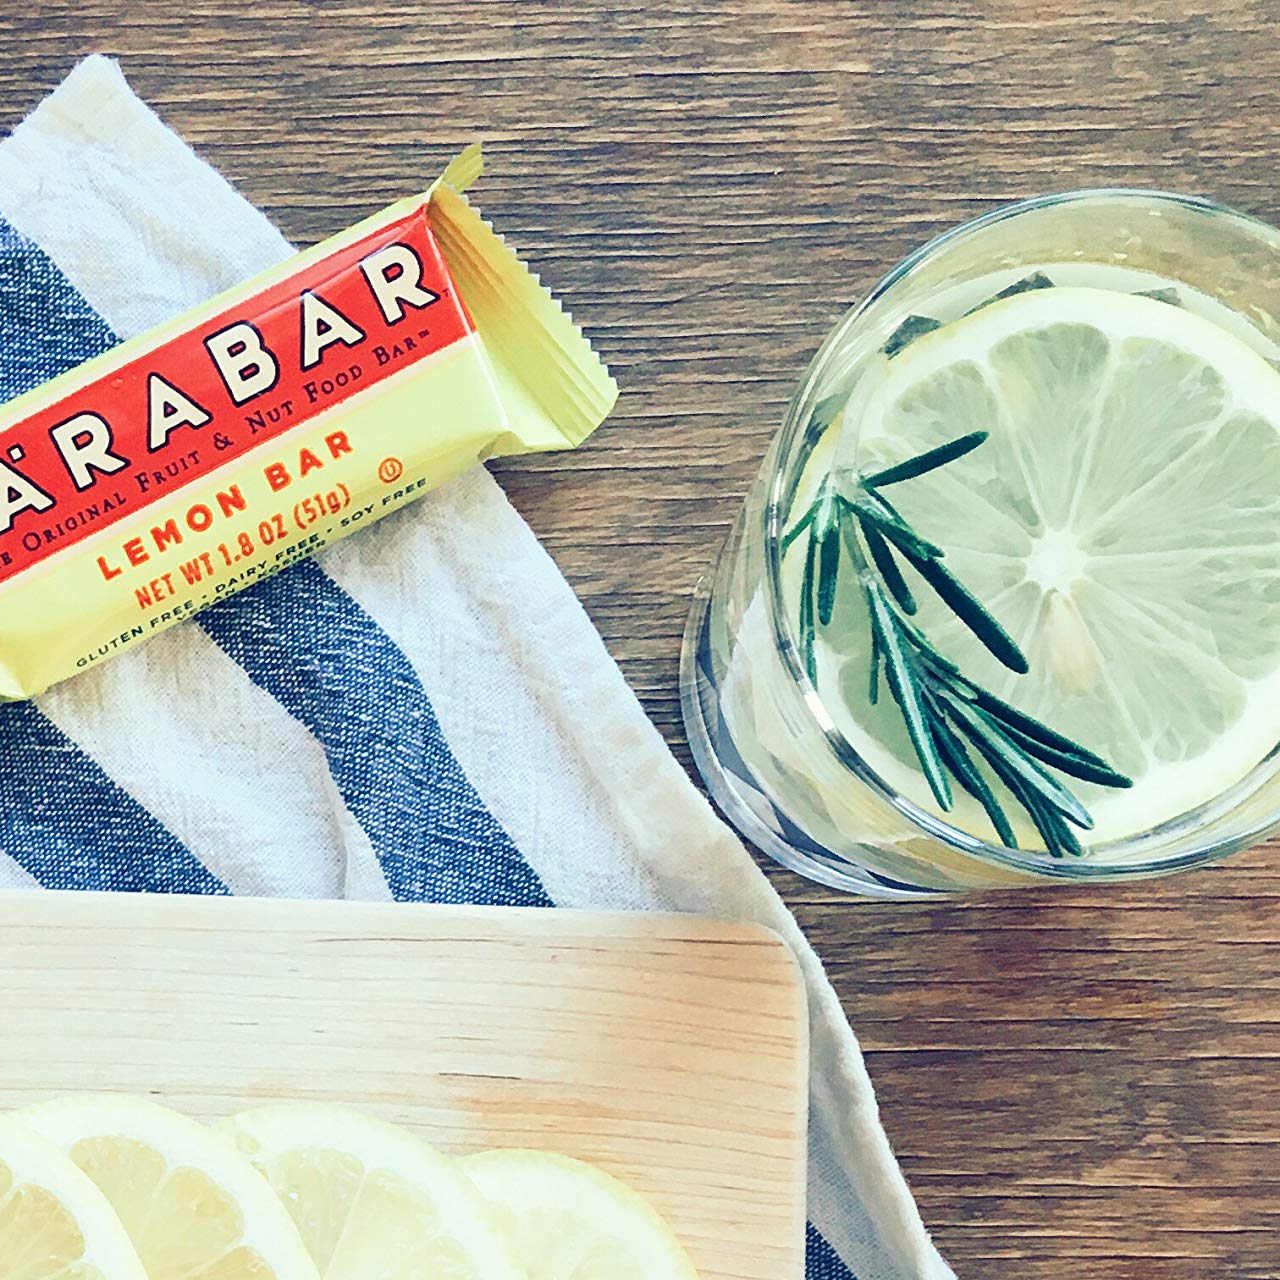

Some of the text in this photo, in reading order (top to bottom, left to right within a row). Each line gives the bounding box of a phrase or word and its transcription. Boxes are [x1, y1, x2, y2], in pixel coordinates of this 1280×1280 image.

[96, 430, 354, 581] LEMON BAR
[213, 431, 234, 451] &
[75, 478, 426, 668] GLUTEN FREE DAIRY FREE SOY FREE
[134, 482, 351, 610] NET WT 1.8 OZ (51g)
